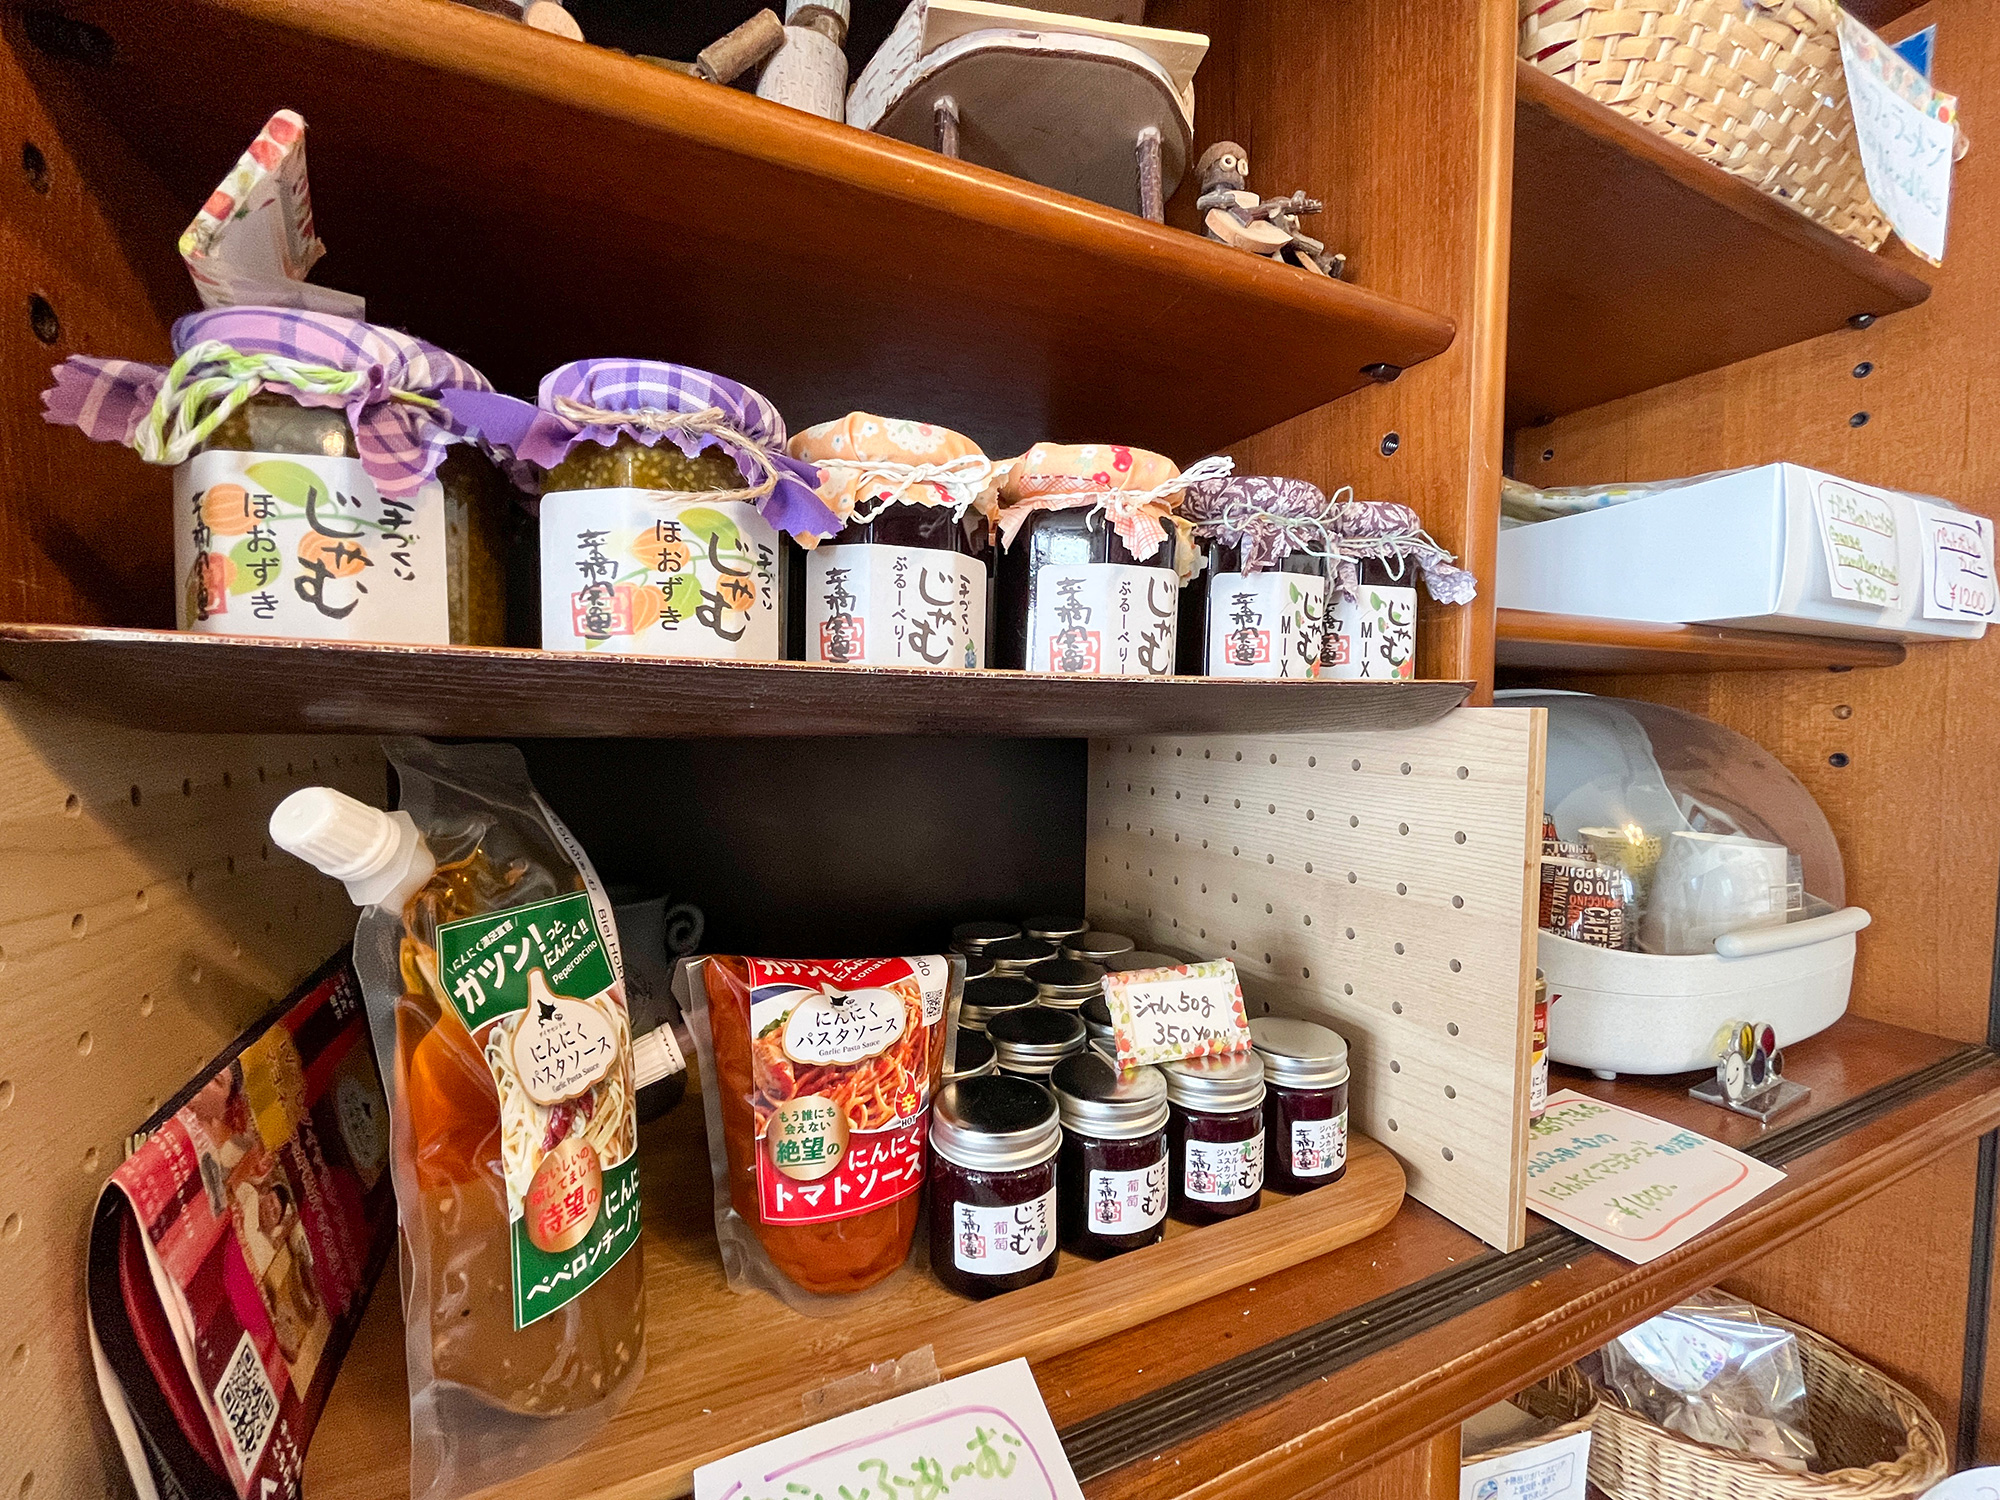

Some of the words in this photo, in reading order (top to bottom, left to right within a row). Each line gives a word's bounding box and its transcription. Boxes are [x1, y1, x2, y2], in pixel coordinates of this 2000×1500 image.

[244, 493, 280, 620] ほおずき
[294, 485, 375, 620] じゃむ
[656, 519, 683, 631] ほおずき
[695, 532, 755, 642] じゃむ
[756, 543, 776, 611] 手づくり
[892, 556, 908, 658] ぶるーべりー
[908, 566, 957, 665] じゃむ
[959, 574, 975, 635] 手づくり
[1118, 581, 1132, 675] ぶるーべりー
[1138, 576, 1172, 675] じゃむ
[1280, 615, 1292, 678] MIX
[1297, 592, 1322, 666] じゃむ
[1360, 622, 1372, 678] MIX
[1380, 599, 1411, 667] じゃむ
[552, 939, 599, 985] Peperoncino
[796, 1017, 898, 1048] パスタソース
[815, 1002, 879, 1027] にんにく
[1152, 1021, 1191, 1045] 350
[529, 1022, 588, 1064] にんにく
[531, 1035, 612, 1091] パスタソース
[818, 1047, 841, 1057] Garlic
[842, 1043, 861, 1054] Pasta
[862, 1038, 881, 1051] Sauce
[552, 1080, 567, 1093] Garlic
[567, 1072, 583, 1086] Pasta
[582, 1062, 600, 1077] Sauce
[779, 1106, 836, 1123] もう誰にも
[901, 1093, 917, 1114] 辛
[901, 1115, 917, 1128] HOT
[776, 1136, 841, 1165] 絶望の
[784, 1121, 832, 1136] 会えない
[849, 1127, 921, 1172] にんにく
[776, 1152, 921, 1213] トマトソース
[1141, 1168, 1160, 1216] じゃむ
[1216, 1149, 1224, 1196] ジュンベリー
[1223, 1148, 1232, 1188] ハスカップ
[1231, 1148, 1240, 1195] ブルーベリー
[1539, 1140, 1659, 1201] にんにくマヨネーズ
[1126, 1178, 1140, 1208] 葡萄
[993, 1221, 1008, 1252] 葡萄
[1009, 1205, 1036, 1256] じゃむ
